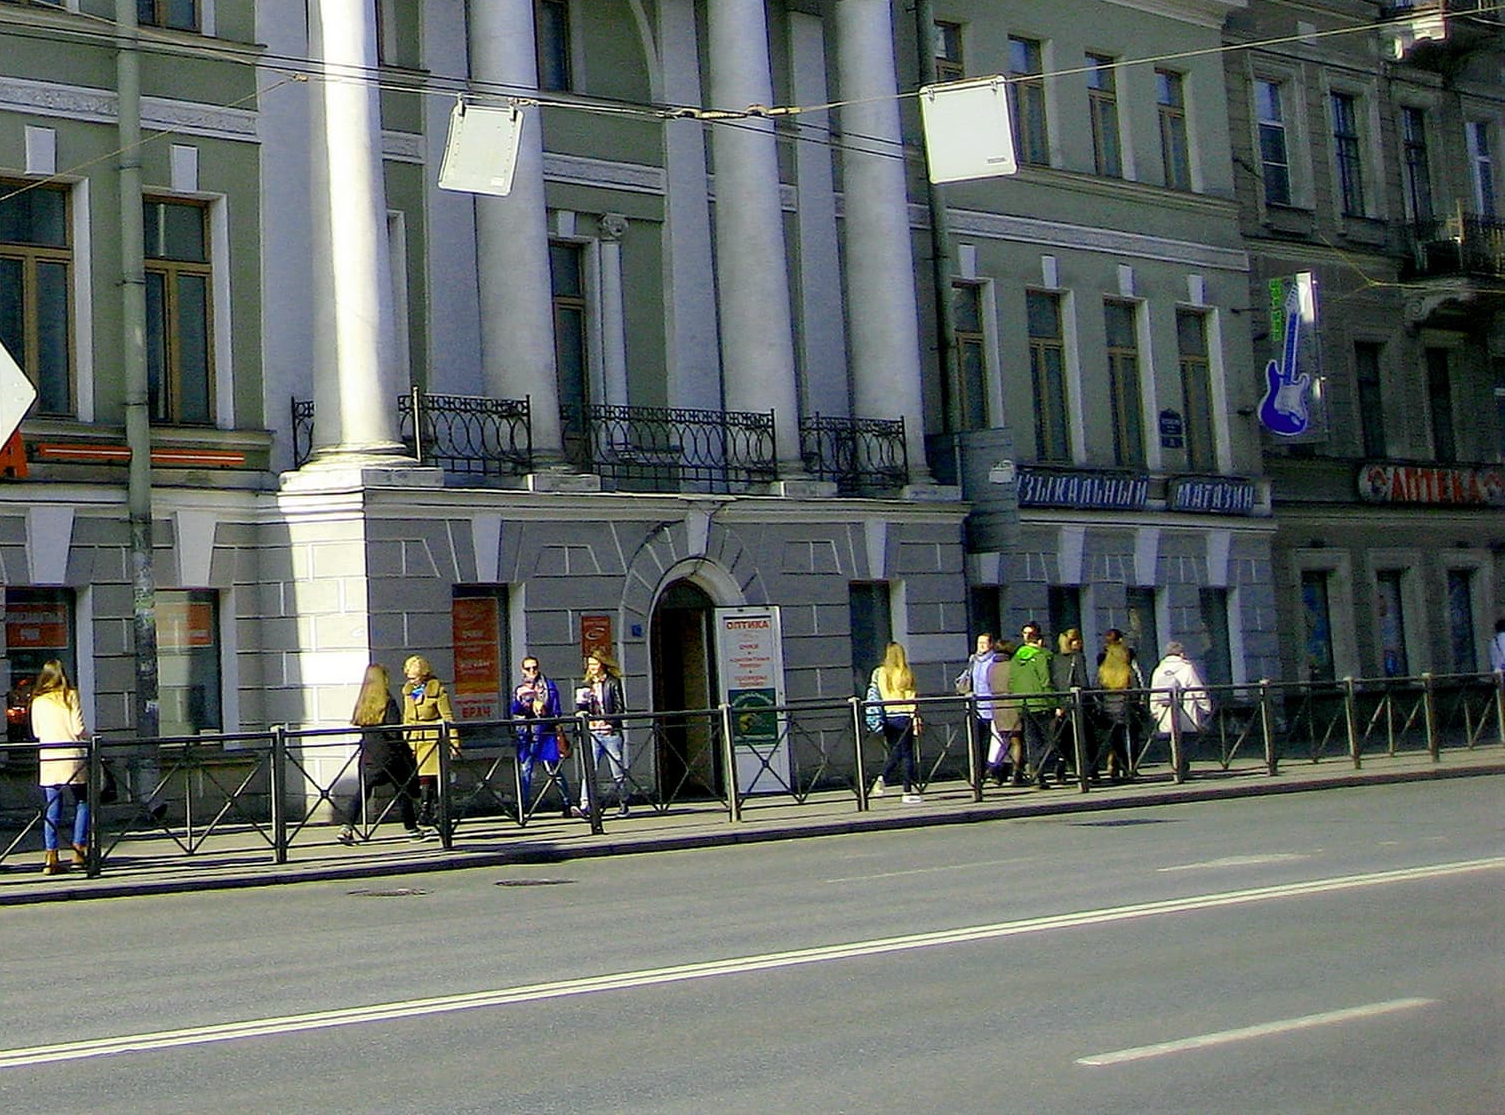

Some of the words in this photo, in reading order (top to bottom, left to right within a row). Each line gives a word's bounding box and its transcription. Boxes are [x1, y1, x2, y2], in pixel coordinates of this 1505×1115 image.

[1177, 483, 1254, 510] МАГАЗИН
[1390, 467, 1486, 504] АПТЕКА
[726, 620, 769, 630] ОПТИКА
